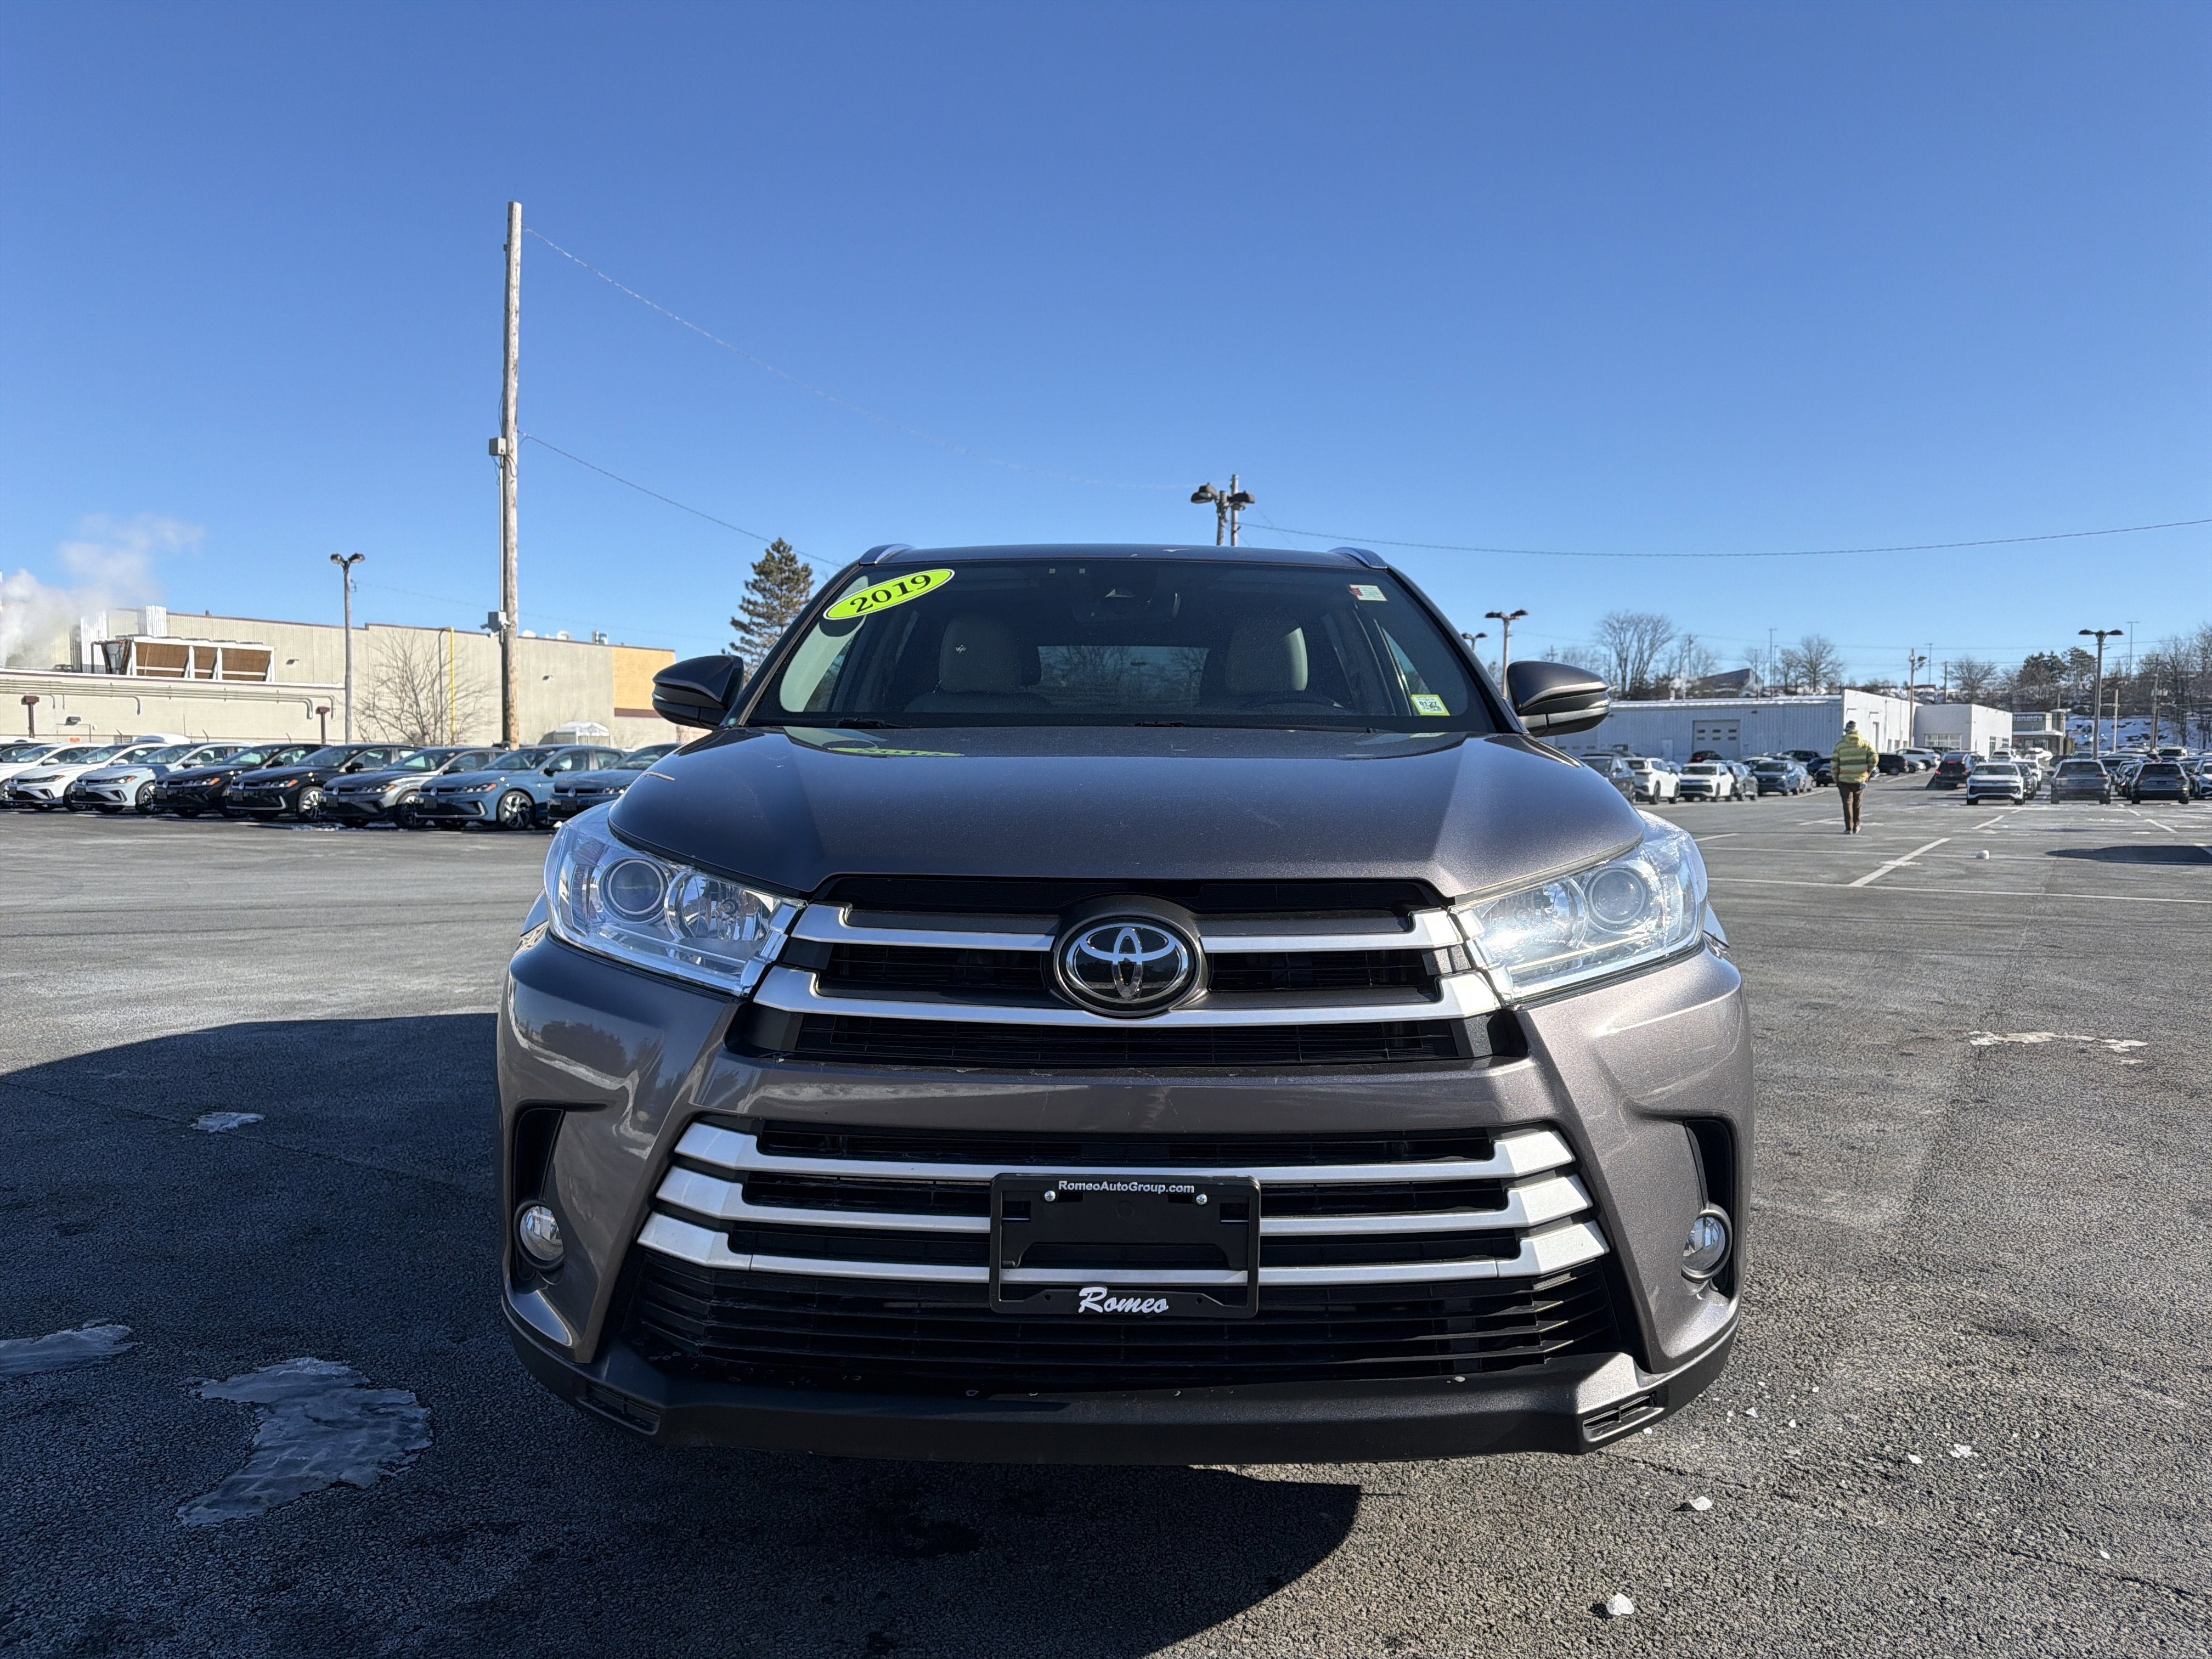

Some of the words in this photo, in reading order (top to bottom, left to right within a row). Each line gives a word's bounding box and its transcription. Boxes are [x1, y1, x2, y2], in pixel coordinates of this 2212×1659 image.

[850, 575, 931, 613] 2019
[1058, 1180, 1194, 1194] RomeoAutoGroup.com
[1078, 1286, 1169, 1314] Romeo
